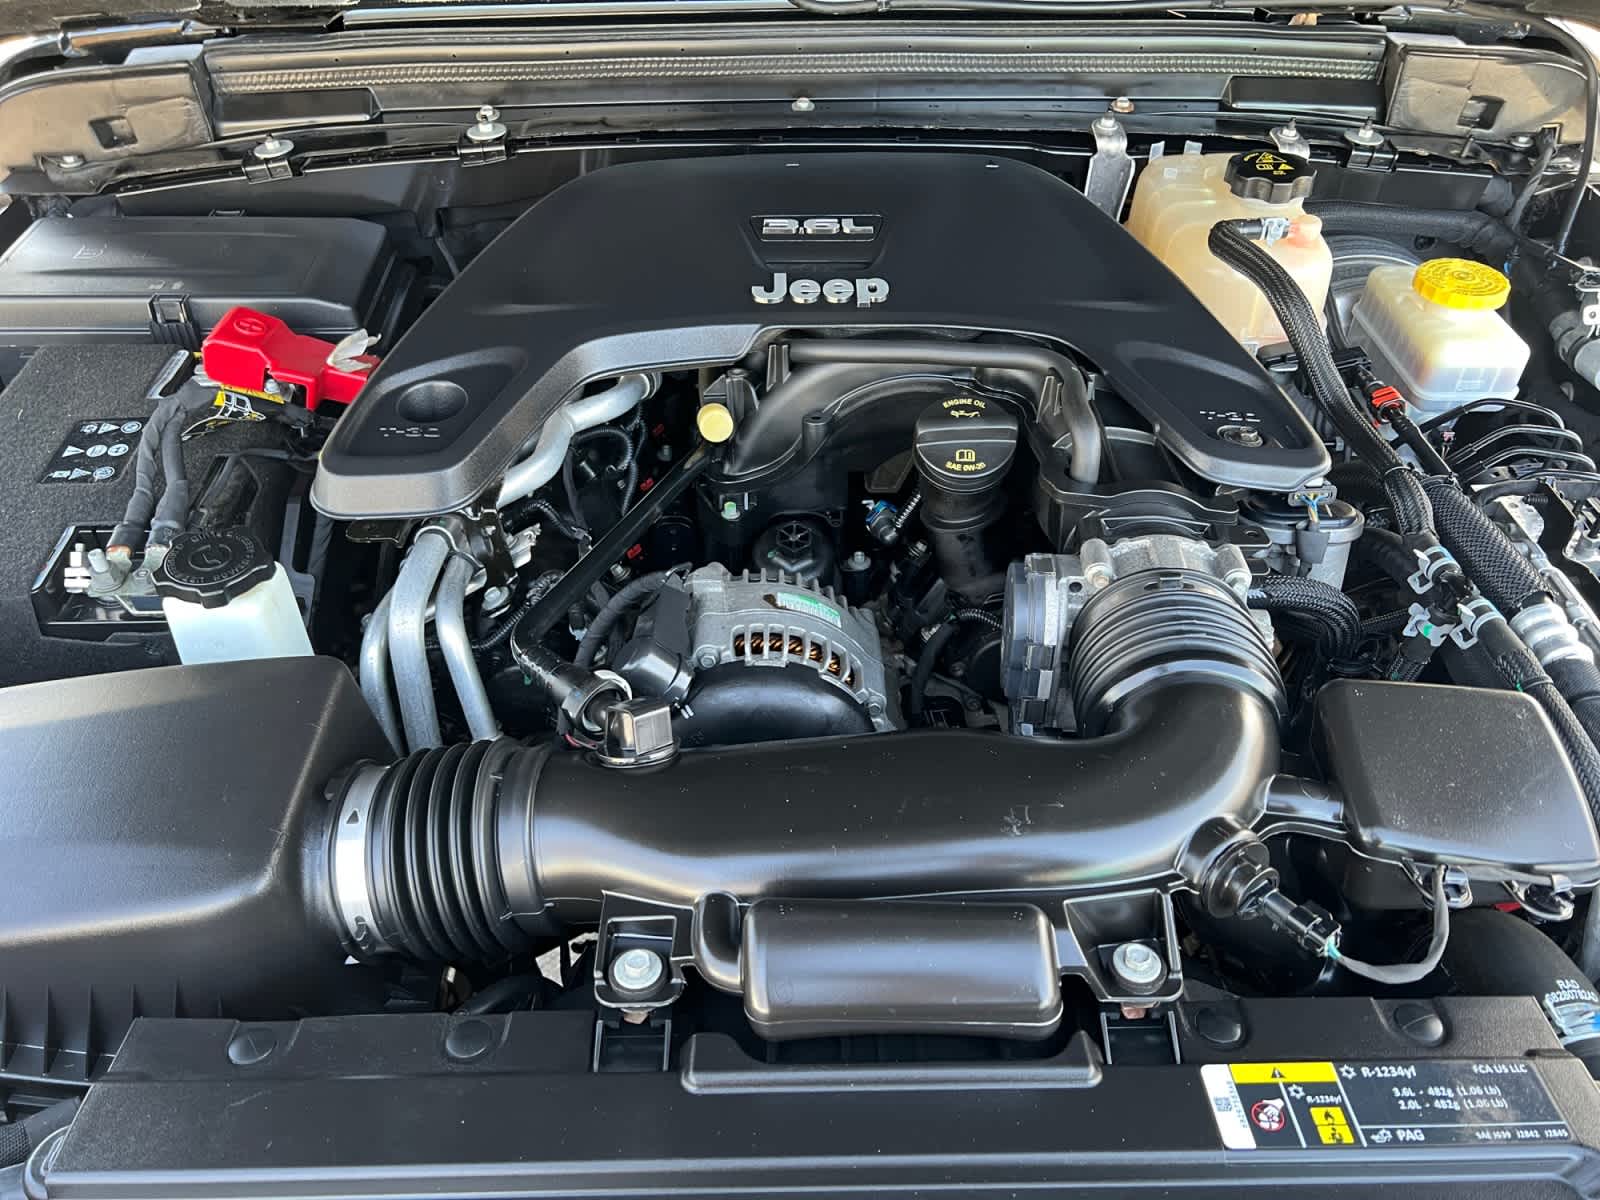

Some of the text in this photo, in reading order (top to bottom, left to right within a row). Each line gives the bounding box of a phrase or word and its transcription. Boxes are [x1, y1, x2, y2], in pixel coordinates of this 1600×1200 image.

[762, 217, 874, 235] 3.6L
[751, 272, 890, 308] Jeep
[942, 398, 986, 409] ENGINE OIL
[945, 461, 962, 470] SAE
[1360, 1065, 1417, 1079] R-1234yf
[1472, 1063, 1528, 1074] FCA US LLC
[1392, 1086, 1416, 1097] 3.6L
[1398, 1099, 1422, 1110] 2.0L
[1396, 1129, 1425, 1141] PAG
